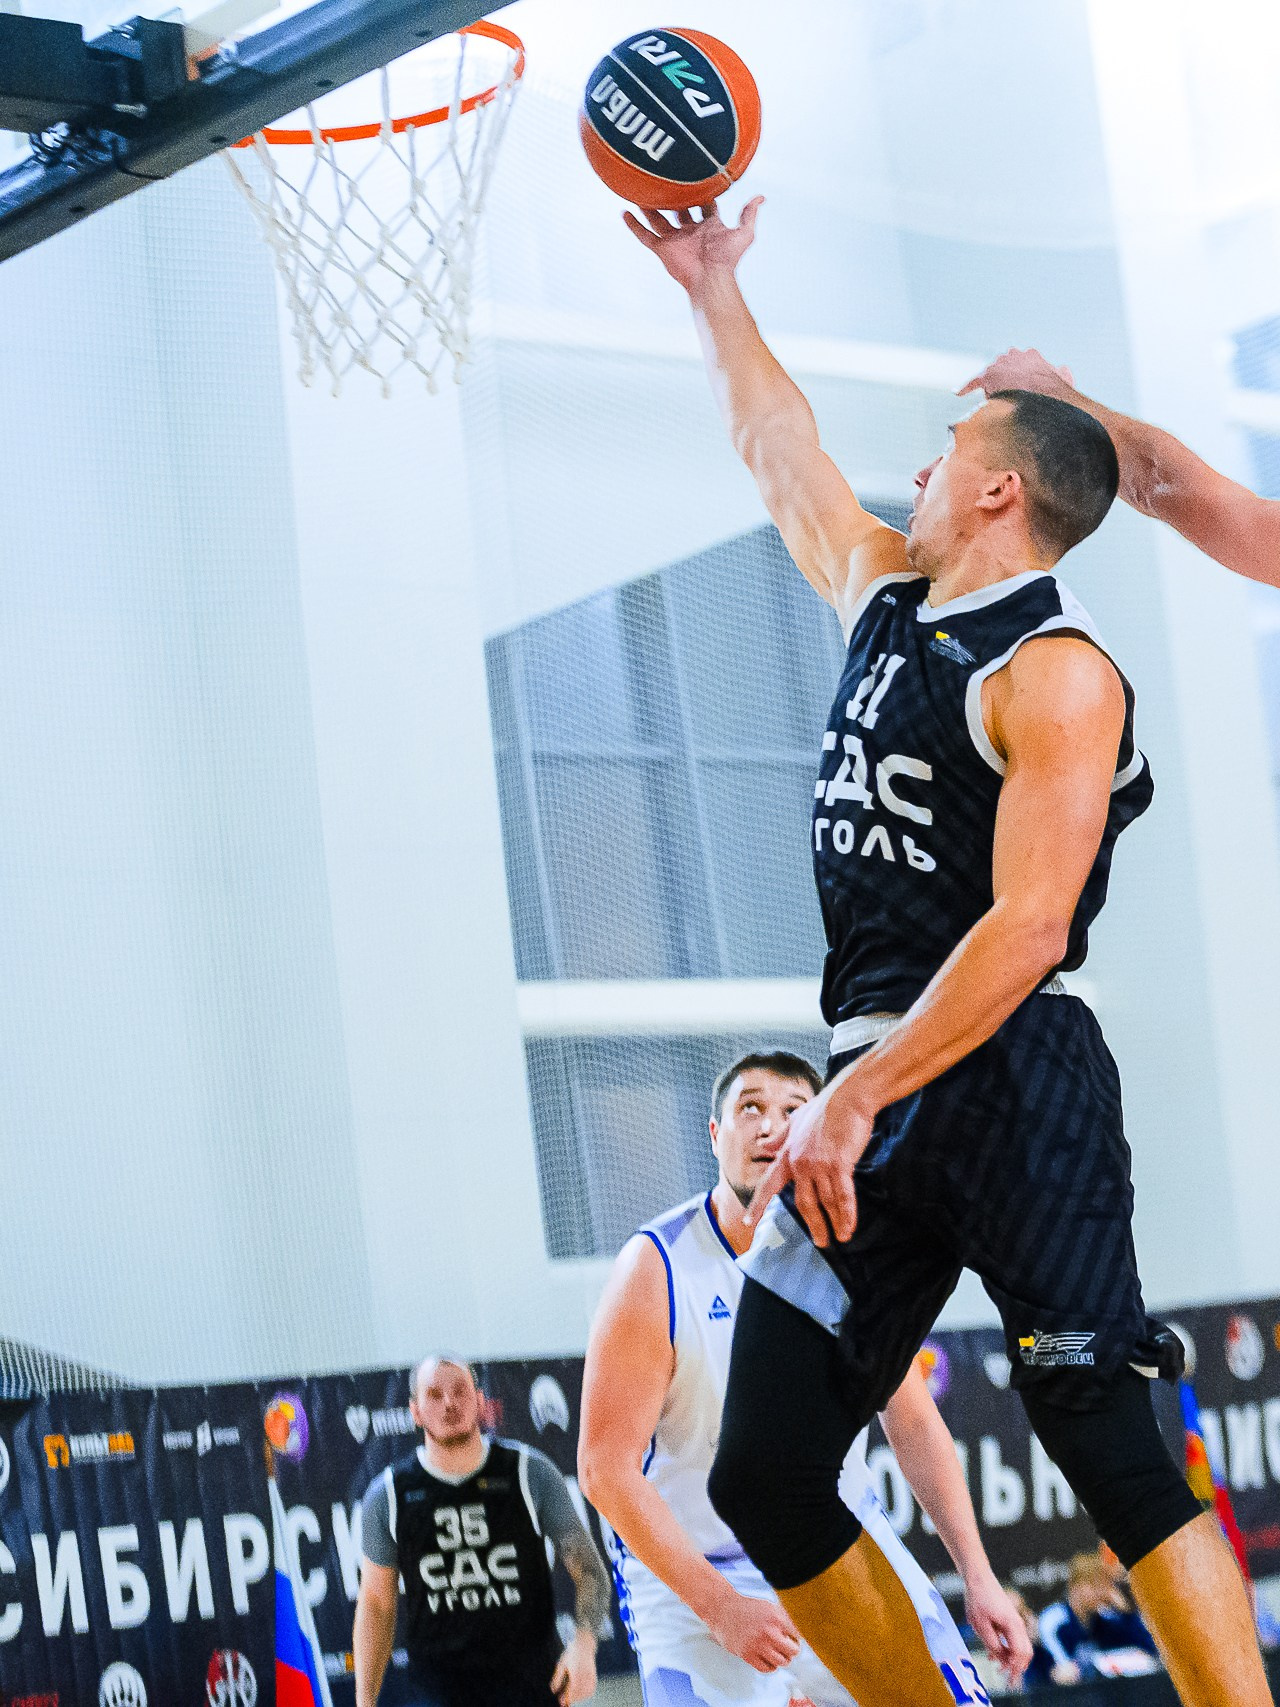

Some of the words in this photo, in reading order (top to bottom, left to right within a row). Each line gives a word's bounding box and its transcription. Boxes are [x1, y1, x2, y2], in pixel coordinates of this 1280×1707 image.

[628, 35, 725, 119] PARI
[590, 74, 676, 162] МЛБЛ
[813, 817, 937, 873] ГОЛЬ
[433, 1503, 490, 1552] 35
